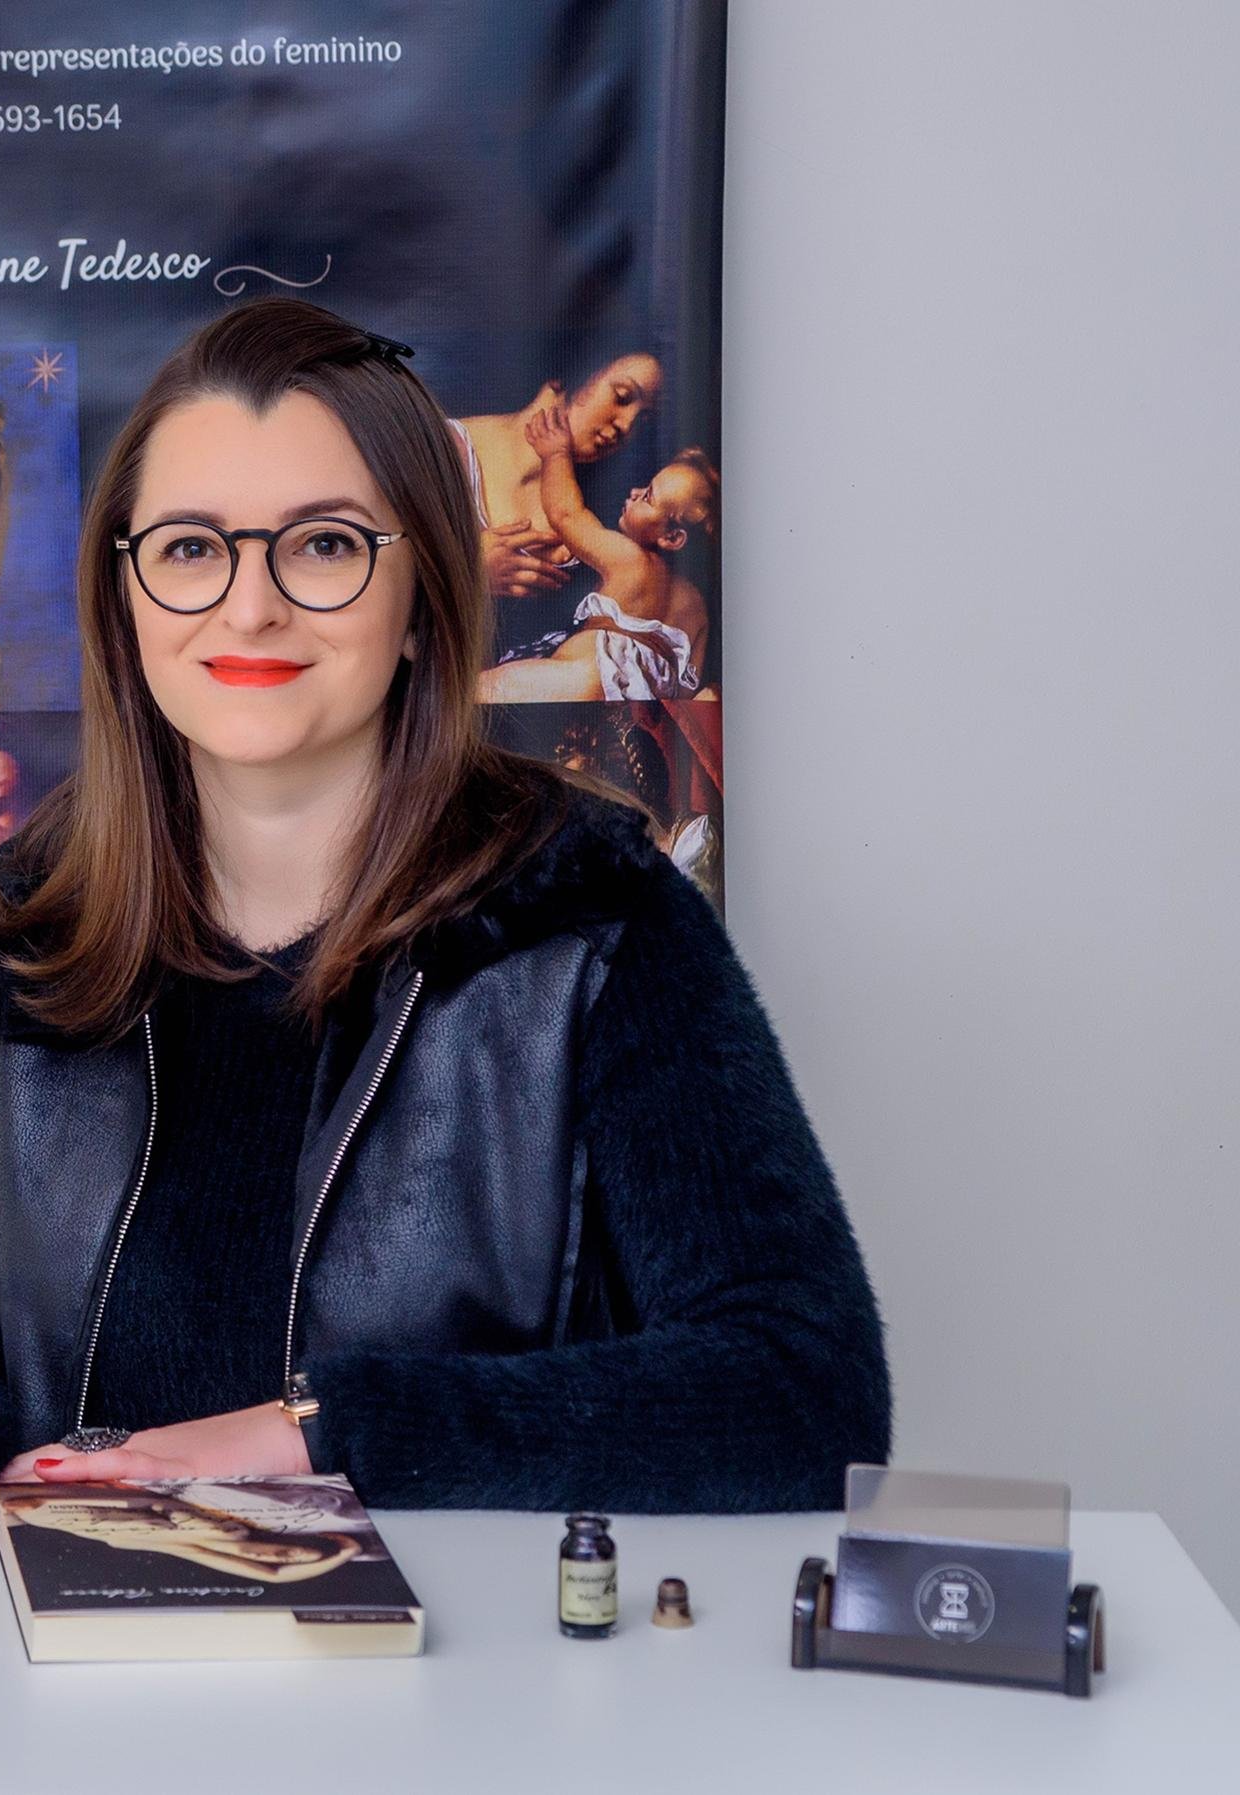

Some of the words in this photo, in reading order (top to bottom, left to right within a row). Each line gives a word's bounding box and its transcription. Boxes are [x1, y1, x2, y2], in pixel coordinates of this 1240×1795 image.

[0, 42, 223, 78] representações
[230, 38, 266, 66] do
[274, 36, 402, 66] feminino
[58, 238, 210, 291] Tedesco
